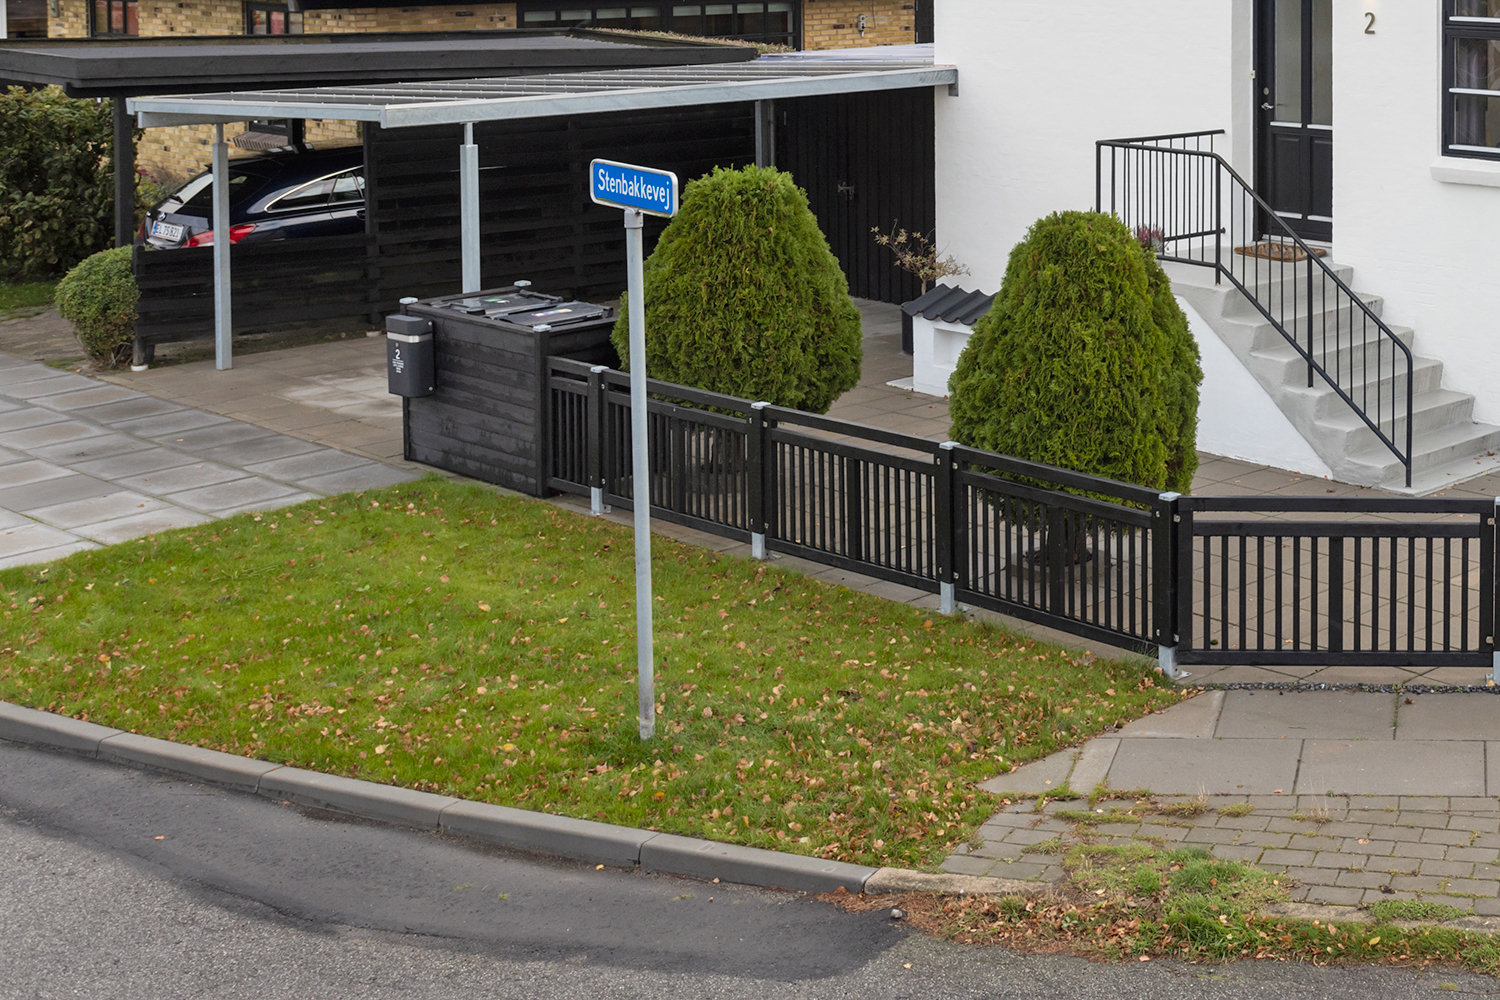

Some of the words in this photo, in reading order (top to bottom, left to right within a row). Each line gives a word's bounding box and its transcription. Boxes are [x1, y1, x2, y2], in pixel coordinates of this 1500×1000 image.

[1364, 11, 1376, 35] 2
[598, 168, 670, 211] Stenbakkevej
[395, 348, 401, 360] 2
